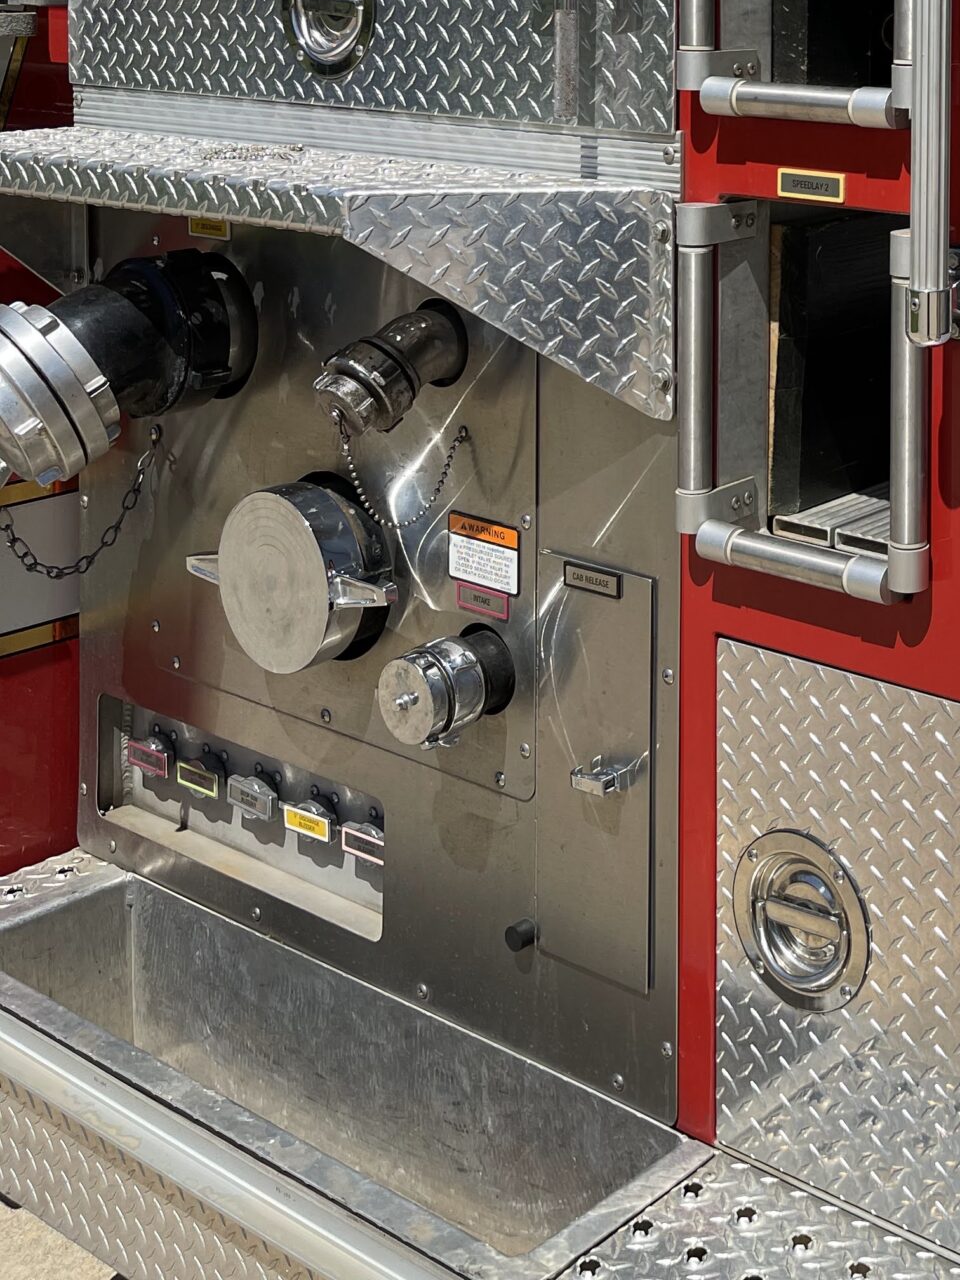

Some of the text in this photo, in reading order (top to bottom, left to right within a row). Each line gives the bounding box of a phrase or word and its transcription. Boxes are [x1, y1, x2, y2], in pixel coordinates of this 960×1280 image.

[792, 180, 829, 192] SPEEDLAY 2
[468, 524, 506, 540] WARNING
[572, 572, 609, 588] CAB RELEASE
[473, 594, 491, 606] INTAKE
